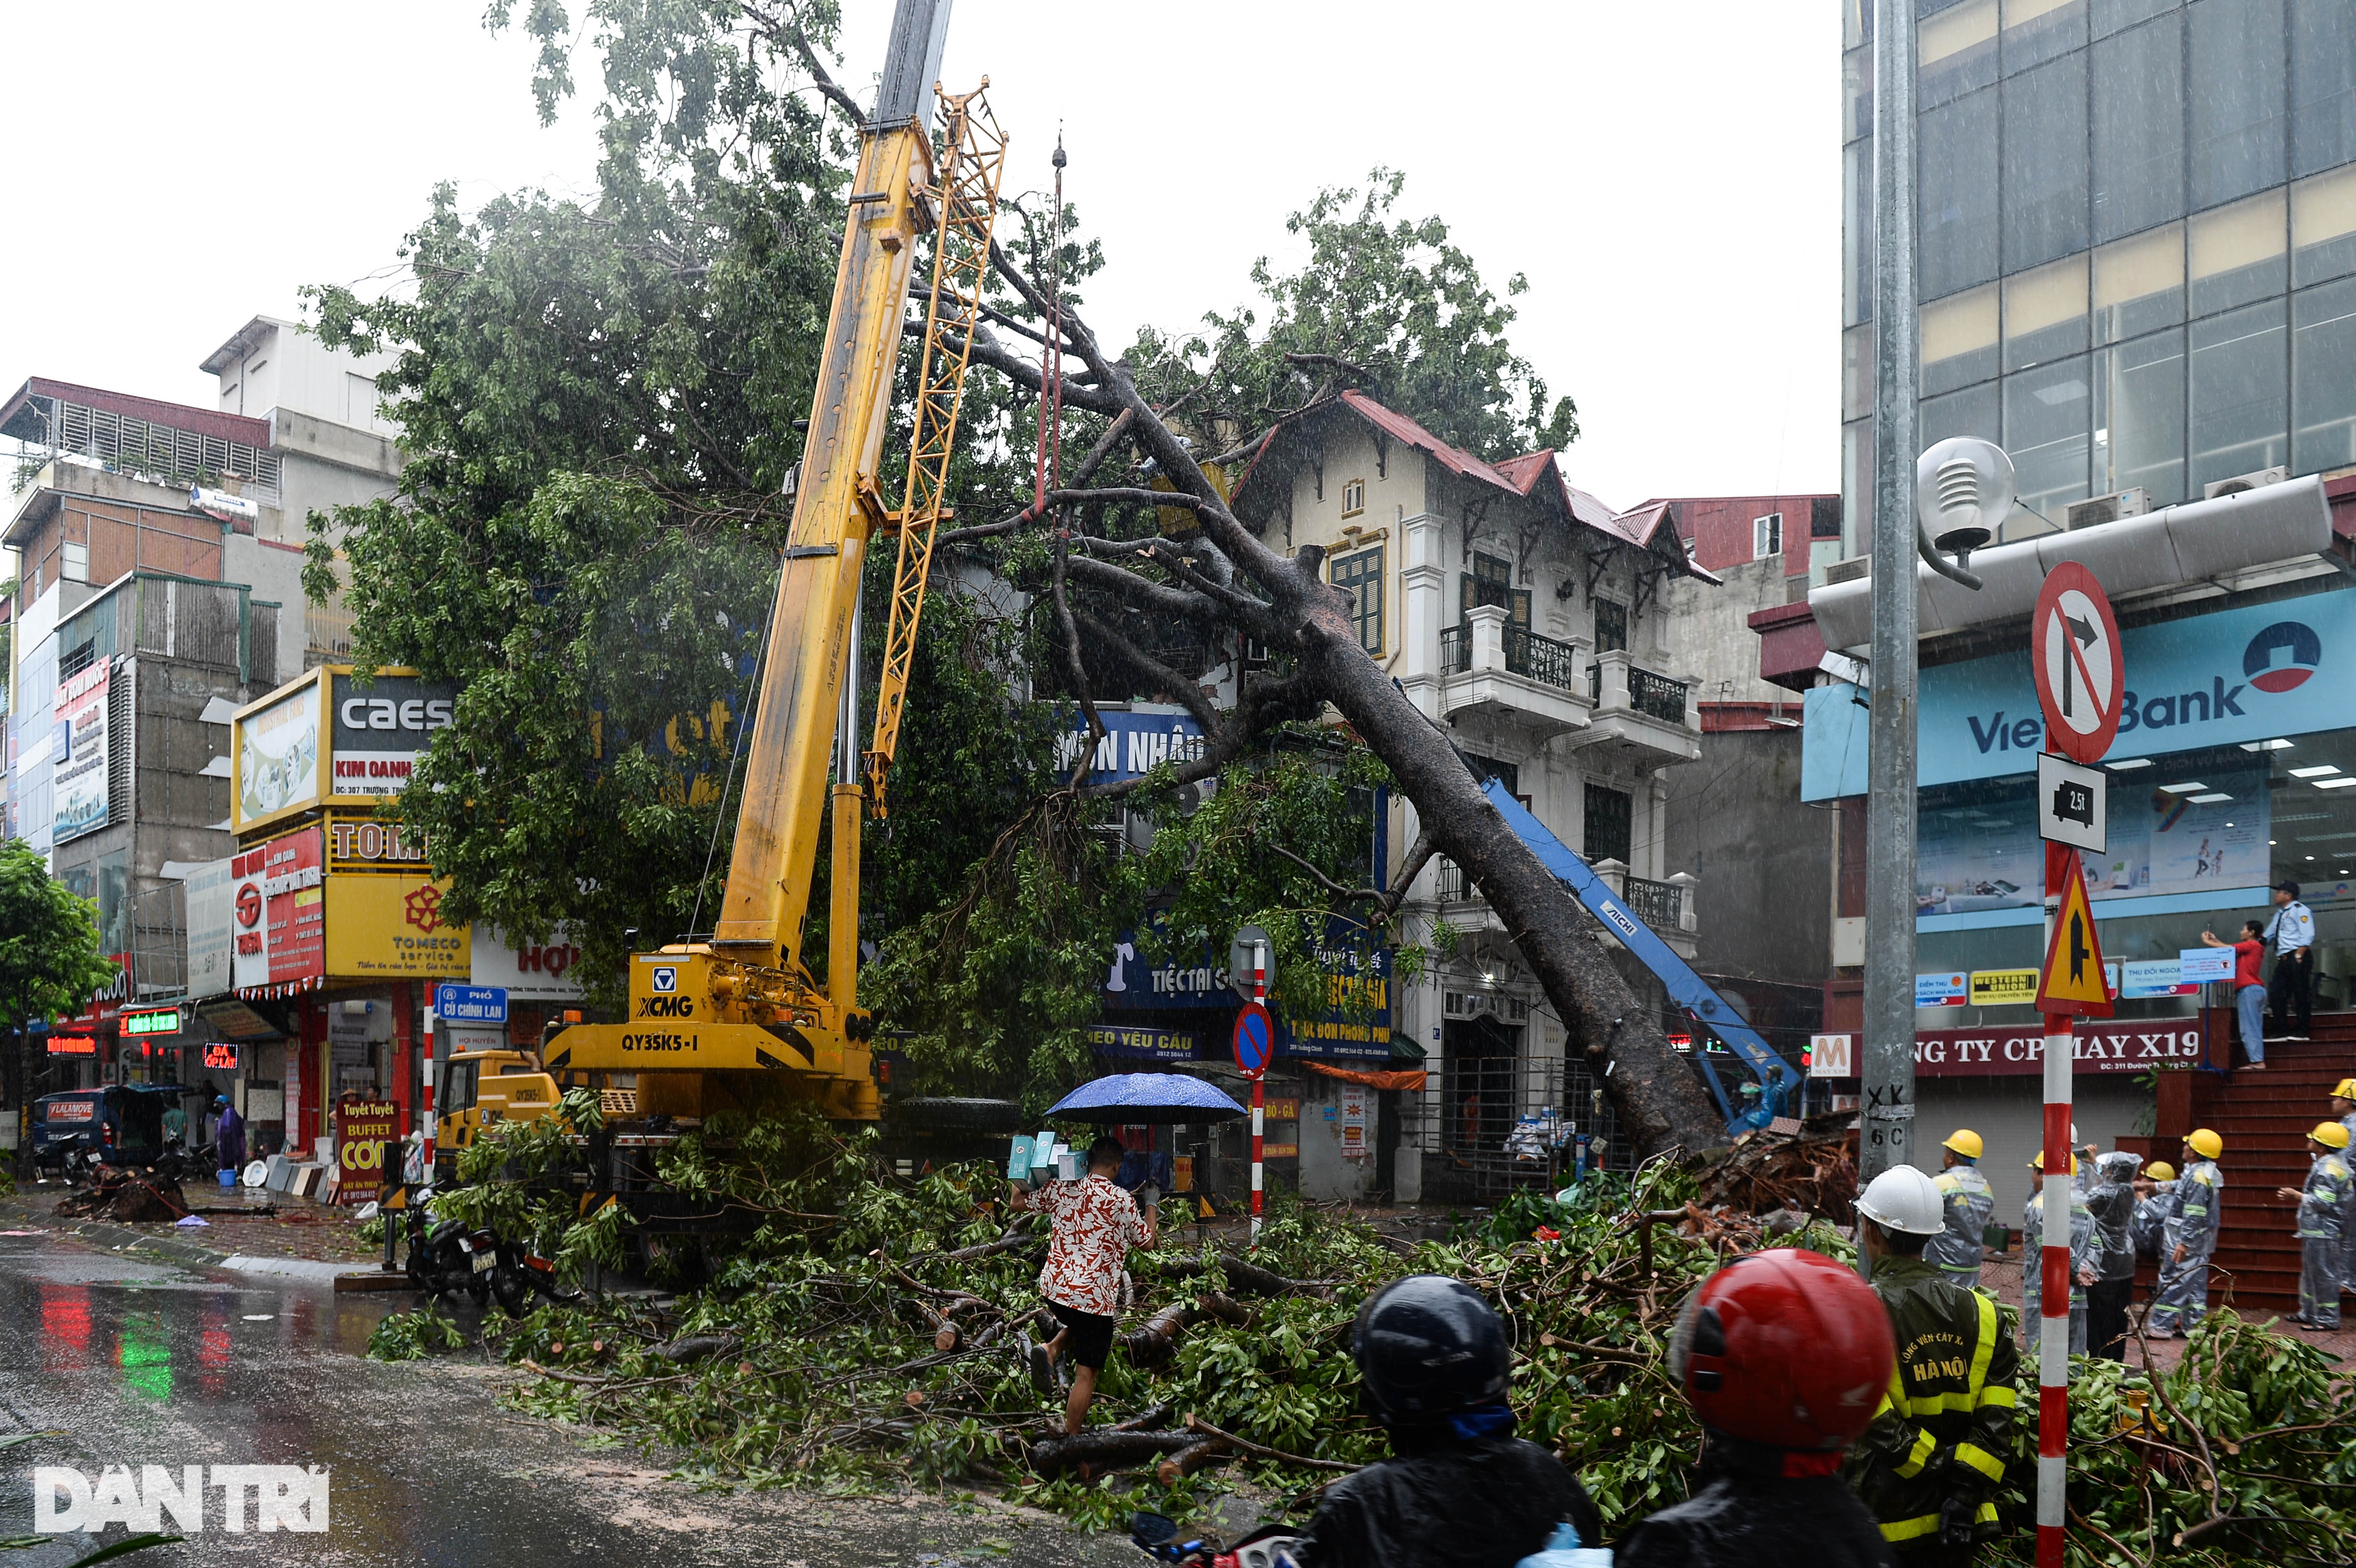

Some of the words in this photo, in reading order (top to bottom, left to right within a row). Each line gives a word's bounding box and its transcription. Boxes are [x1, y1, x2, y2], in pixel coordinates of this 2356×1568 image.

[335, 761, 365, 777] KIM
[369, 761, 412, 778] OANH
[2070, 790, 2085, 811] 2,5t
[332, 824, 432, 859] TOM
[1607, 909, 1634, 933] AICHI
[393, 937, 461, 949] TOMECO
[400, 951, 453, 961] service
[1151, 963, 1185, 999] TIỆC
[1187, 968, 1212, 998] TẠI
[1974, 976, 2027, 985] WESTERN
[469, 989, 492, 1000] PHỐ
[457, 1002, 482, 1017] CHÍNH
[485, 1005, 502, 1018] LAN
[636, 996, 693, 1018] XCMG
[1121, 1031, 1152, 1047] YÊU
[1291, 1020, 1315, 1042] TỰC
[1954, 1040, 1996, 1062] TY
[2004, 1038, 2045, 1062] CP
[2137, 1031, 2199, 1058] X19
[56, 1104, 92, 1113] LALAMOVE
[344, 1102, 368, 1118] Tuyết
[369, 1101, 394, 1118] Tuyết
[1266, 1101, 1277, 1117] BÒ
[1283, 1101, 1294, 1118] GÀ
[348, 1124, 391, 1136] BUFFET
[1916, 1334, 1934, 1346] VIÊN
[1936, 1332, 1954, 1342] CÂY
[1913, 1358, 1940, 1382] HÀ
[1940, 1356, 1968, 1380] NỘI
